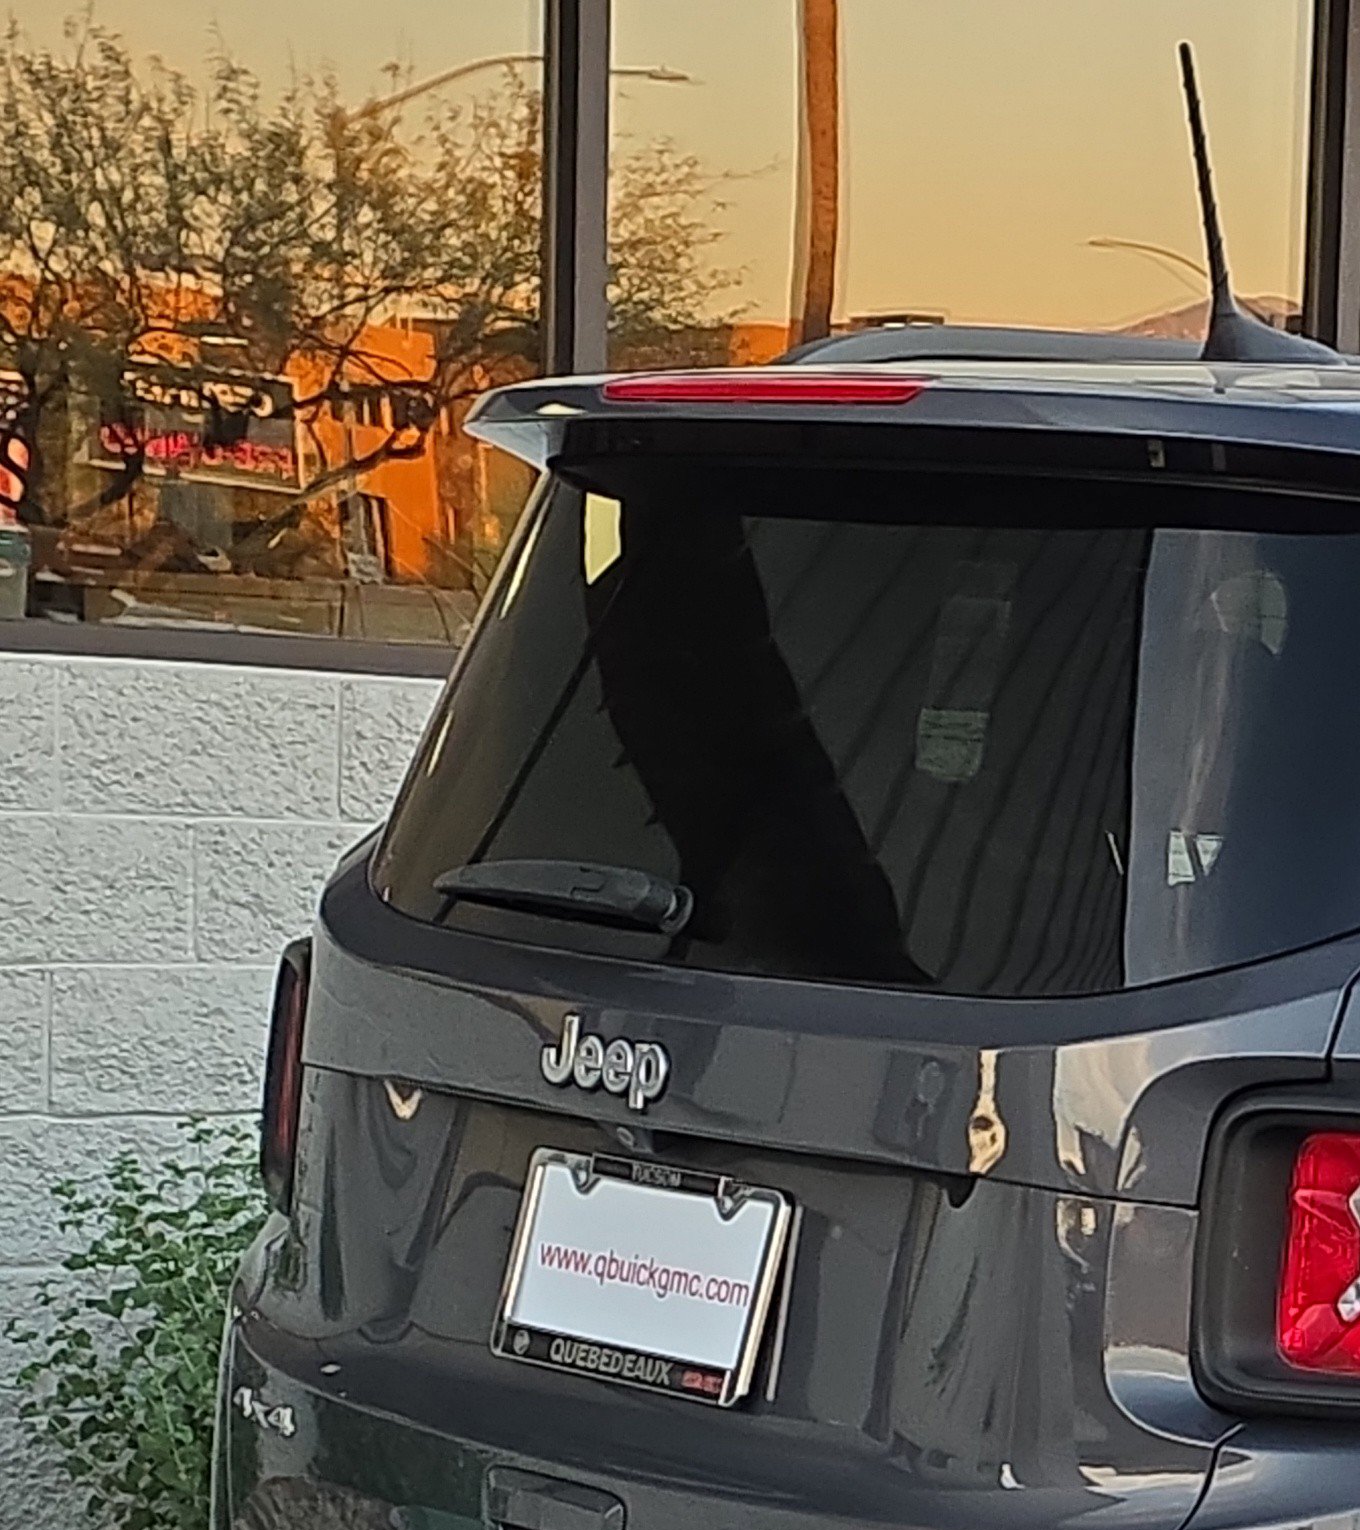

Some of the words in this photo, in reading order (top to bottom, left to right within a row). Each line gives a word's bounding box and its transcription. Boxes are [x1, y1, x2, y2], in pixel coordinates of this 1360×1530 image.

[541, 1014, 670, 1110] Jeep
[631, 1162, 682, 1187] TUCSON
[540, 1243, 750, 1308] www.qbuickgmc.com
[549, 1337, 674, 1387] QUEBEDEAUX
